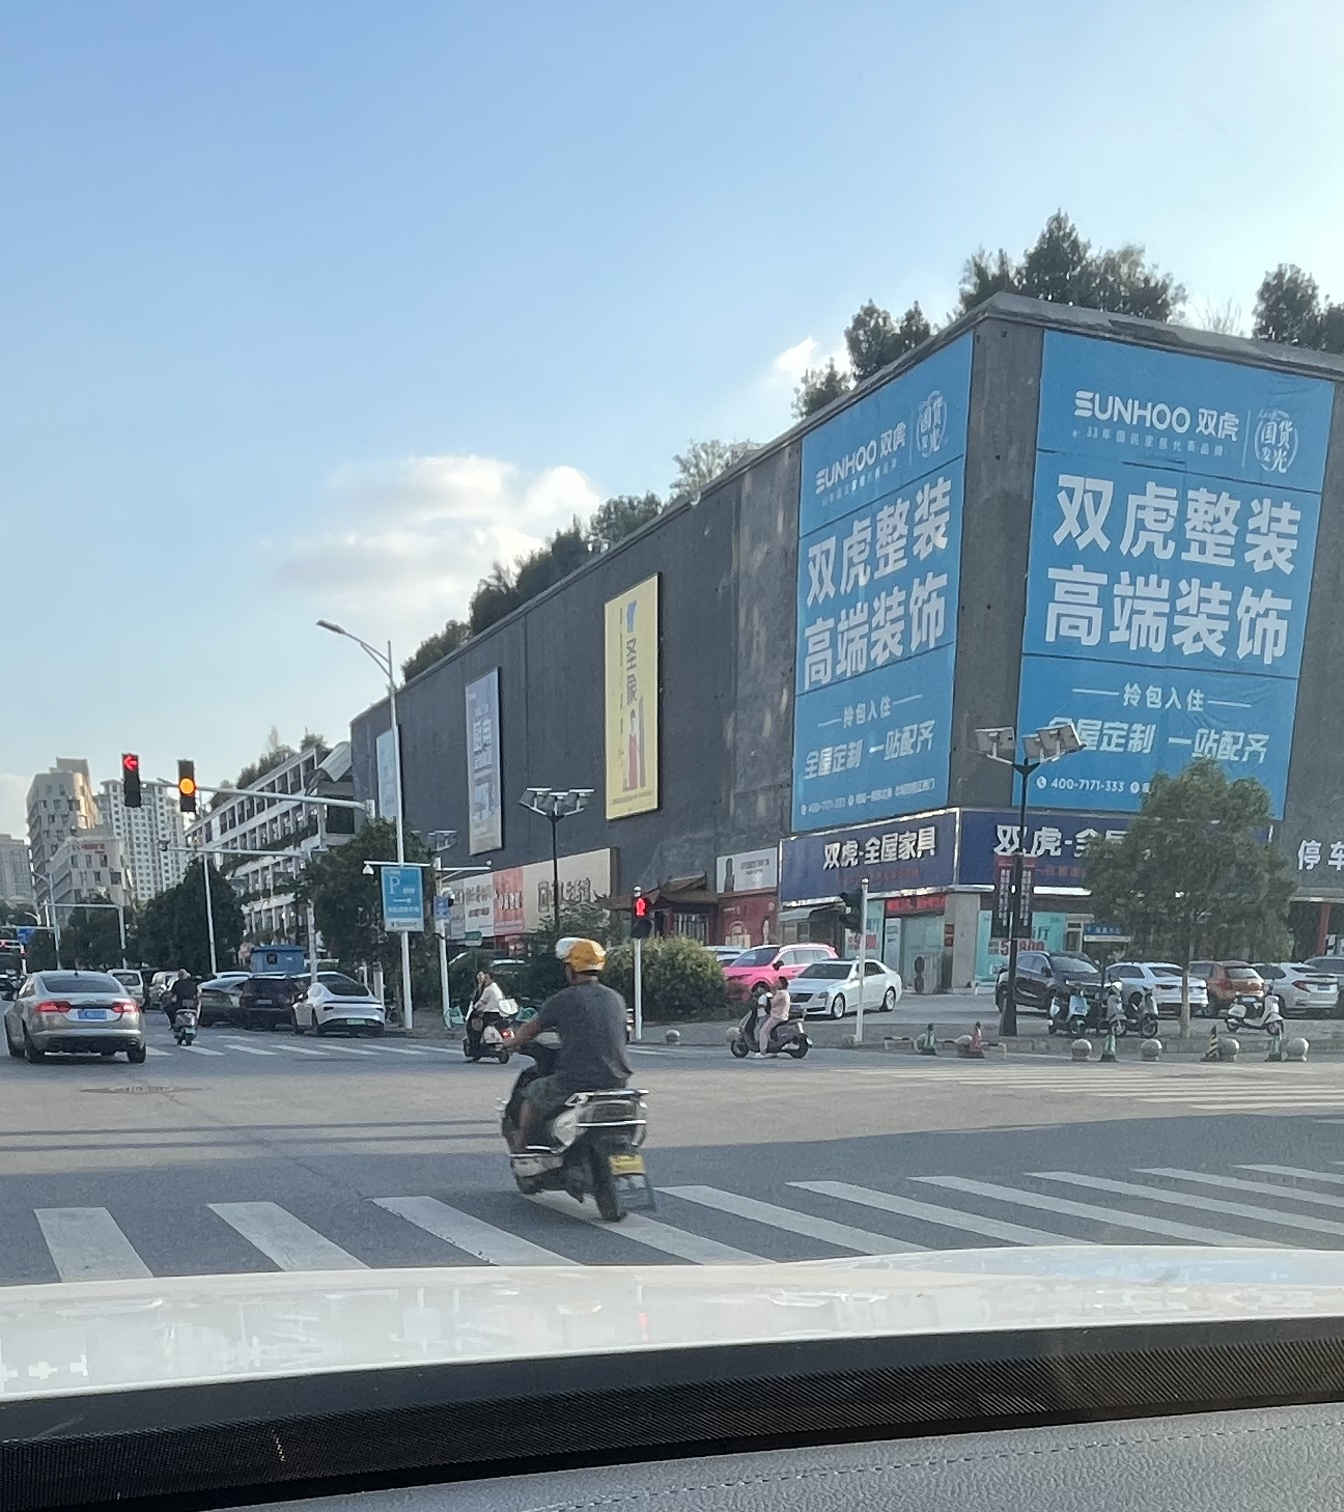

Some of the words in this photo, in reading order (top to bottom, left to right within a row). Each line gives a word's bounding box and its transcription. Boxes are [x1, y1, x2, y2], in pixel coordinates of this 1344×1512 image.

[1074, 390, 1191, 433] SUNHOO
[1196, 408, 1239, 442] 双虎
[816, 440, 877, 495] SUNHOO
[880, 422, 906, 458] 双虎
[807, 476, 952, 608] 双虎整装
[1052, 474, 1302, 575] 双虎整装
[805, 572, 948, 689] 高端装饰
[1045, 564, 1293, 665] 高端装饰
[1123, 683, 1205, 712] 拎包入住
[805, 739, 864, 780] 全屋定制
[869, 719, 936, 760] 一站配齐
[1168, 727, 1271, 764] 一站配齐
[1051, 777, 1124, 794] 400-7171-333
